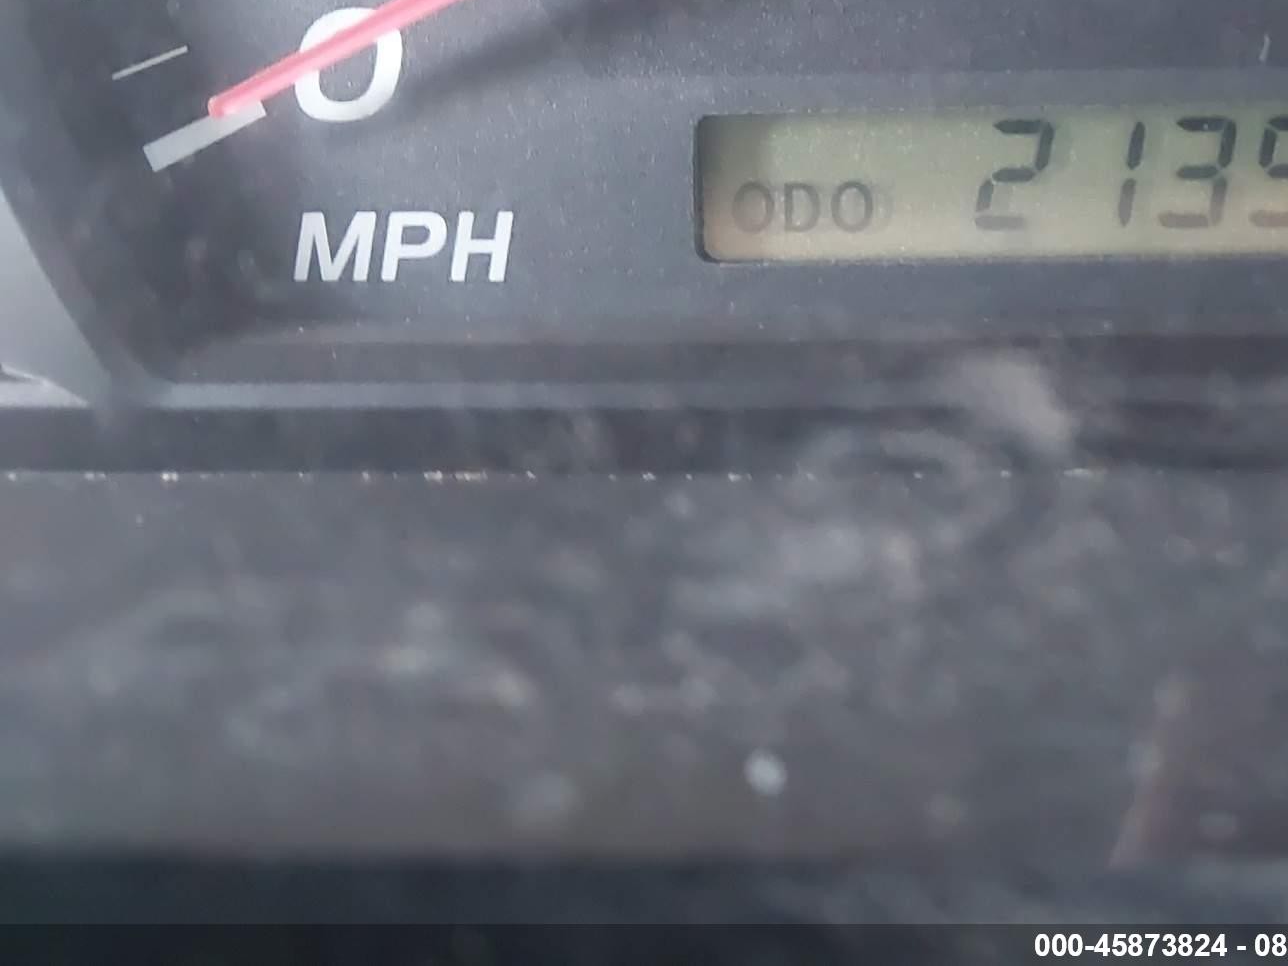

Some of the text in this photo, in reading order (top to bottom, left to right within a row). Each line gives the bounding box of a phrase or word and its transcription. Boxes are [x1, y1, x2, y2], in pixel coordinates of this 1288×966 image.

[292, 7, 402, 121] 0
[732, 180, 874, 233] ODO
[294, 210, 514, 282] MPH
